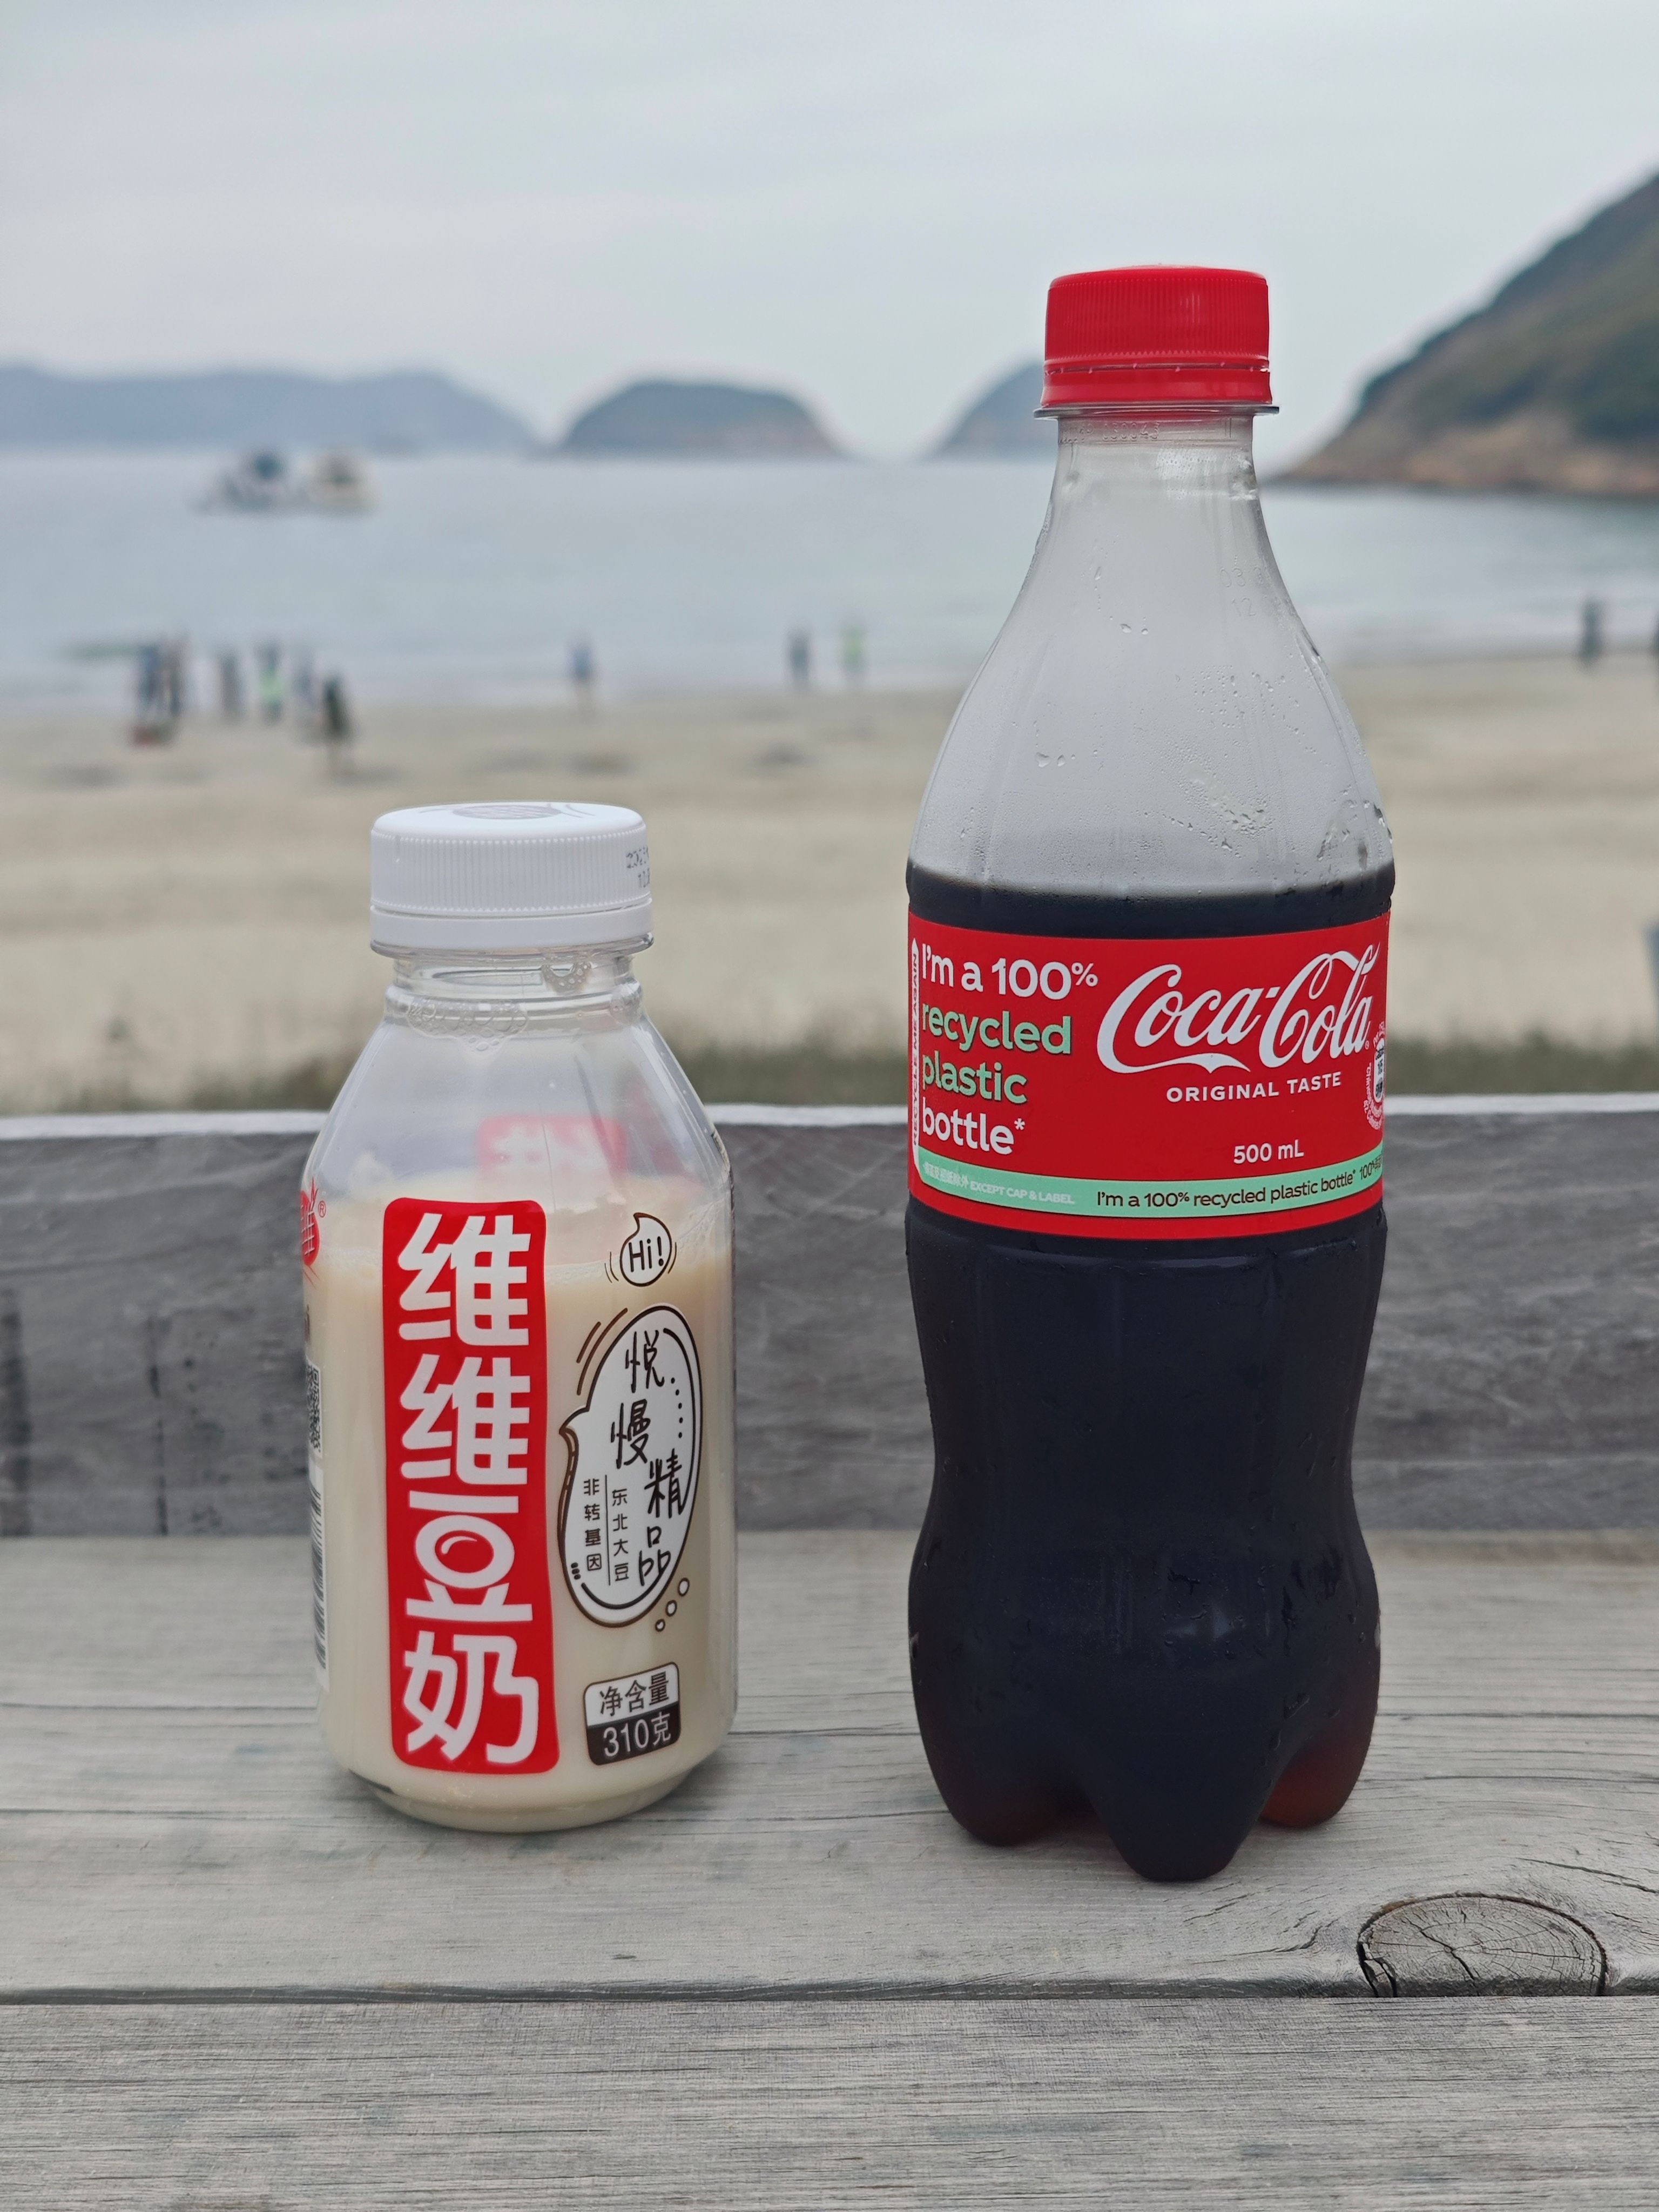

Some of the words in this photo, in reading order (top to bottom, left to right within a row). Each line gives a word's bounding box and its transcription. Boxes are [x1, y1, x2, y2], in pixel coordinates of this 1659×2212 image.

[921, 943, 954, 988] I'm
[961, 966, 984, 993] a
[991, 957, 1098, 1000] 100%
[922, 1002, 1071, 1055] recycled
[1097, 942, 1381, 1074] Coca-Cola
[922, 1050, 1028, 1104] plastic
[1166, 1083, 1279, 1103] ORIGINAL
[1286, 1071, 1342, 1094] TASTE
[1233, 1142, 1272, 1164] 500
[1278, 1139, 1305, 1159] mL
[970, 1181, 1005, 1195] EXCEPT
[1006, 1188, 1028, 1199] CAP
[1029, 1191, 1037, 1201] &
[1038, 1191, 1075, 1204] LABEL
[1097, 1190, 1124, 1208] I'm
[1128, 1195, 1141, 1208] a
[1144, 1191, 1190, 1208] 100%
[1193, 1185, 1266, 1209] recycled
[1270, 1179, 1318, 1204] plastic
[628, 1236, 664, 1274] Hi!
[397, 1211, 540, 1765] 维维豆奶
[583, 1478, 602, 1572] 非转基因
[611, 1487, 630, 1582] 东北大豆
[599, 1670, 670, 1717] 净含量
[603, 1711, 671, 1757] 310克
